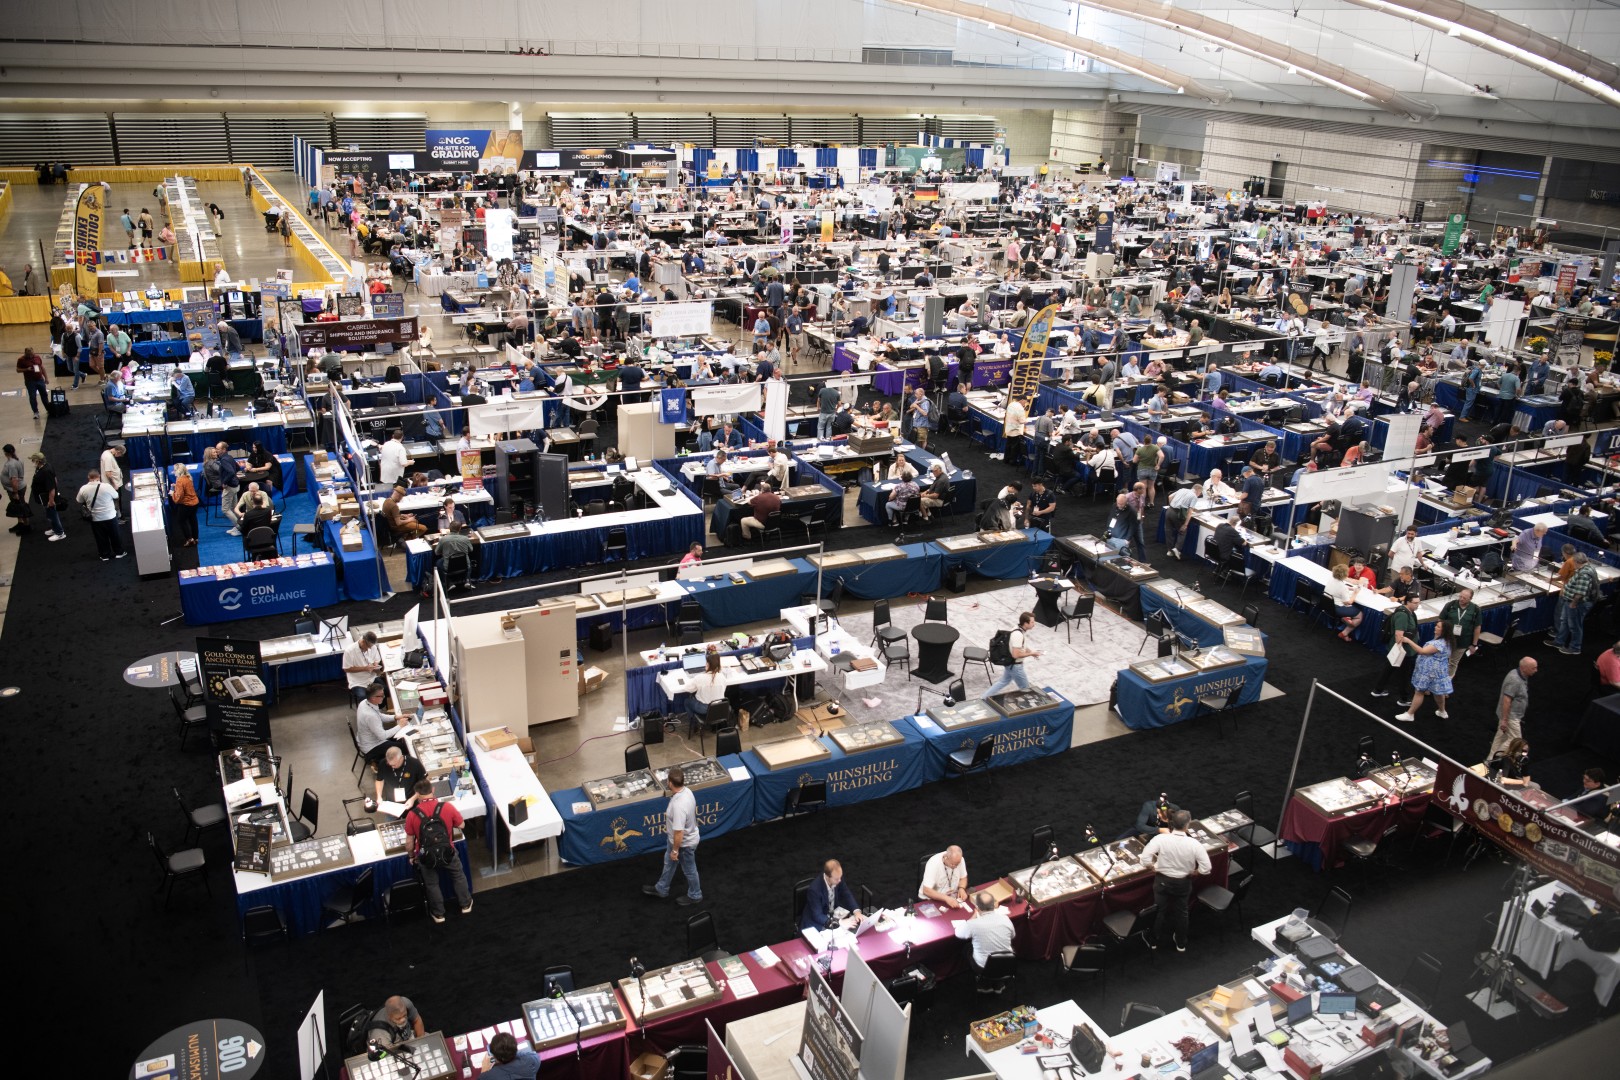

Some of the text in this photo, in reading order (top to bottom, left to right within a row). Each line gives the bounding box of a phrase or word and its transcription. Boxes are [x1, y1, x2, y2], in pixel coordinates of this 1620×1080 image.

[446, 137, 470, 145] NGC
[996, 144, 1003, 154] 9
[431, 150, 480, 158] GRADING
[1020, 352, 1030, 360] &
[250, 584, 275, 596] CDN
[251, 589, 306, 605] EXCHANGE
[180, 658, 196, 674] 800
[1193, 675, 1248, 695] MINSHULL
[994, 725, 1050, 745] INSHULL
[991, 736, 1045, 756] TRADING
[826, 759, 899, 783] MINSHULL
[830, 770, 892, 793] TRADING
[1499, 794, 1530, 819] Stack's
[1531, 812, 1568, 838] Bowers
[1570, 832, 1618, 862] Galleries
[218, 1035, 247, 1073] 900
